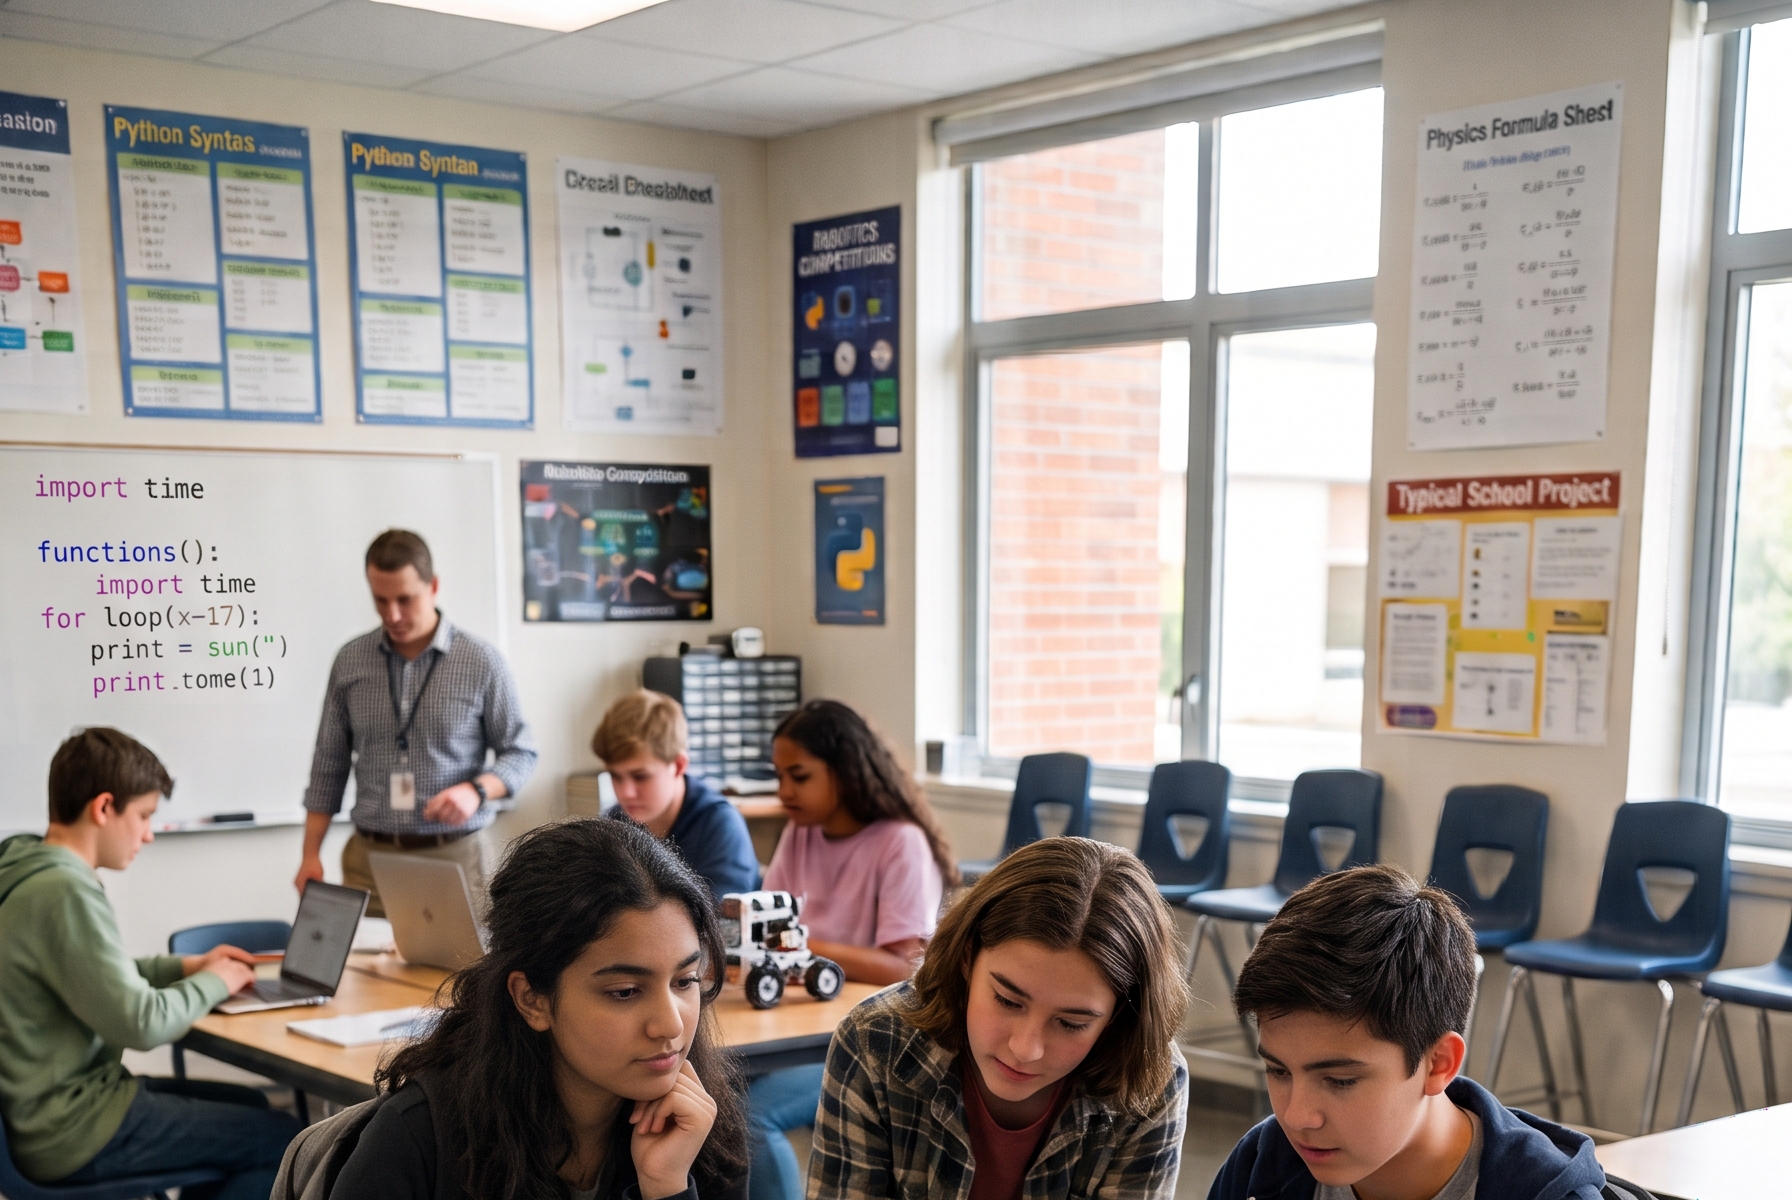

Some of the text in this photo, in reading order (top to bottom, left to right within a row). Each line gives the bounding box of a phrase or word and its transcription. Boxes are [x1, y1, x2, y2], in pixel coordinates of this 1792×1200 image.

[113, 117, 183, 148] Python
[1427, 123, 1487, 150] Physics
[1491, 109, 1559, 139] Formula
[351, 142, 415, 171] Python
[35, 474, 204, 503] import time
[1396, 477, 1612, 514] Typical School Project
[38, 540, 218, 565] functions():
[96, 573, 256, 599] import time
[41, 607, 86, 628] for
[91, 639, 164, 666] print
[179, 643, 192, 653] =
